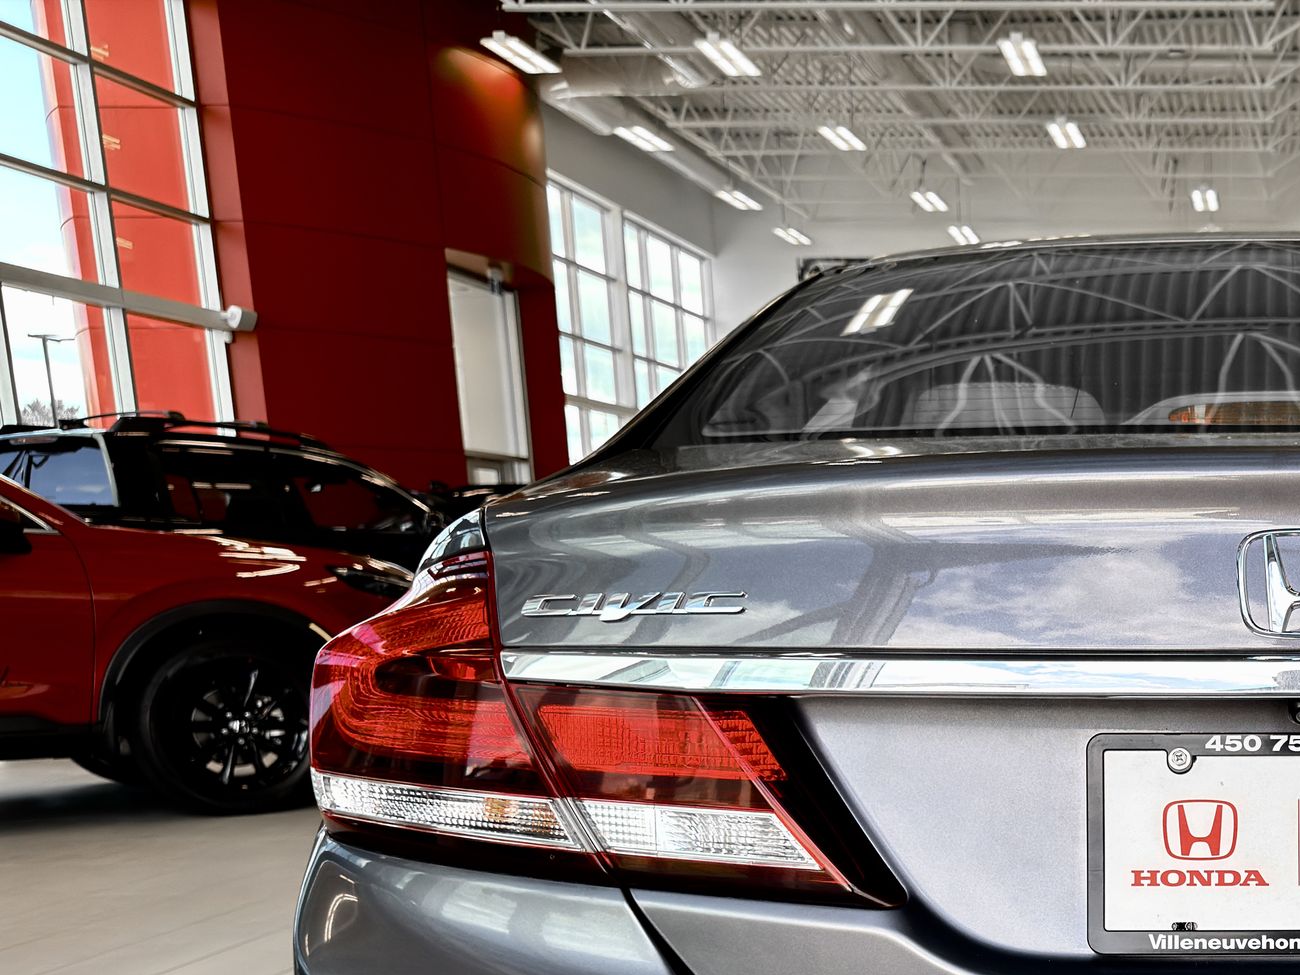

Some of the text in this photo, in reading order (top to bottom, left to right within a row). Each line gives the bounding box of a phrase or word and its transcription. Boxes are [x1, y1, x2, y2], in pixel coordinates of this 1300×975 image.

[520, 591, 749, 623] CIVIC
[1204, 734, 1262, 752] 450
[1130, 869, 1270, 887] HONDA
